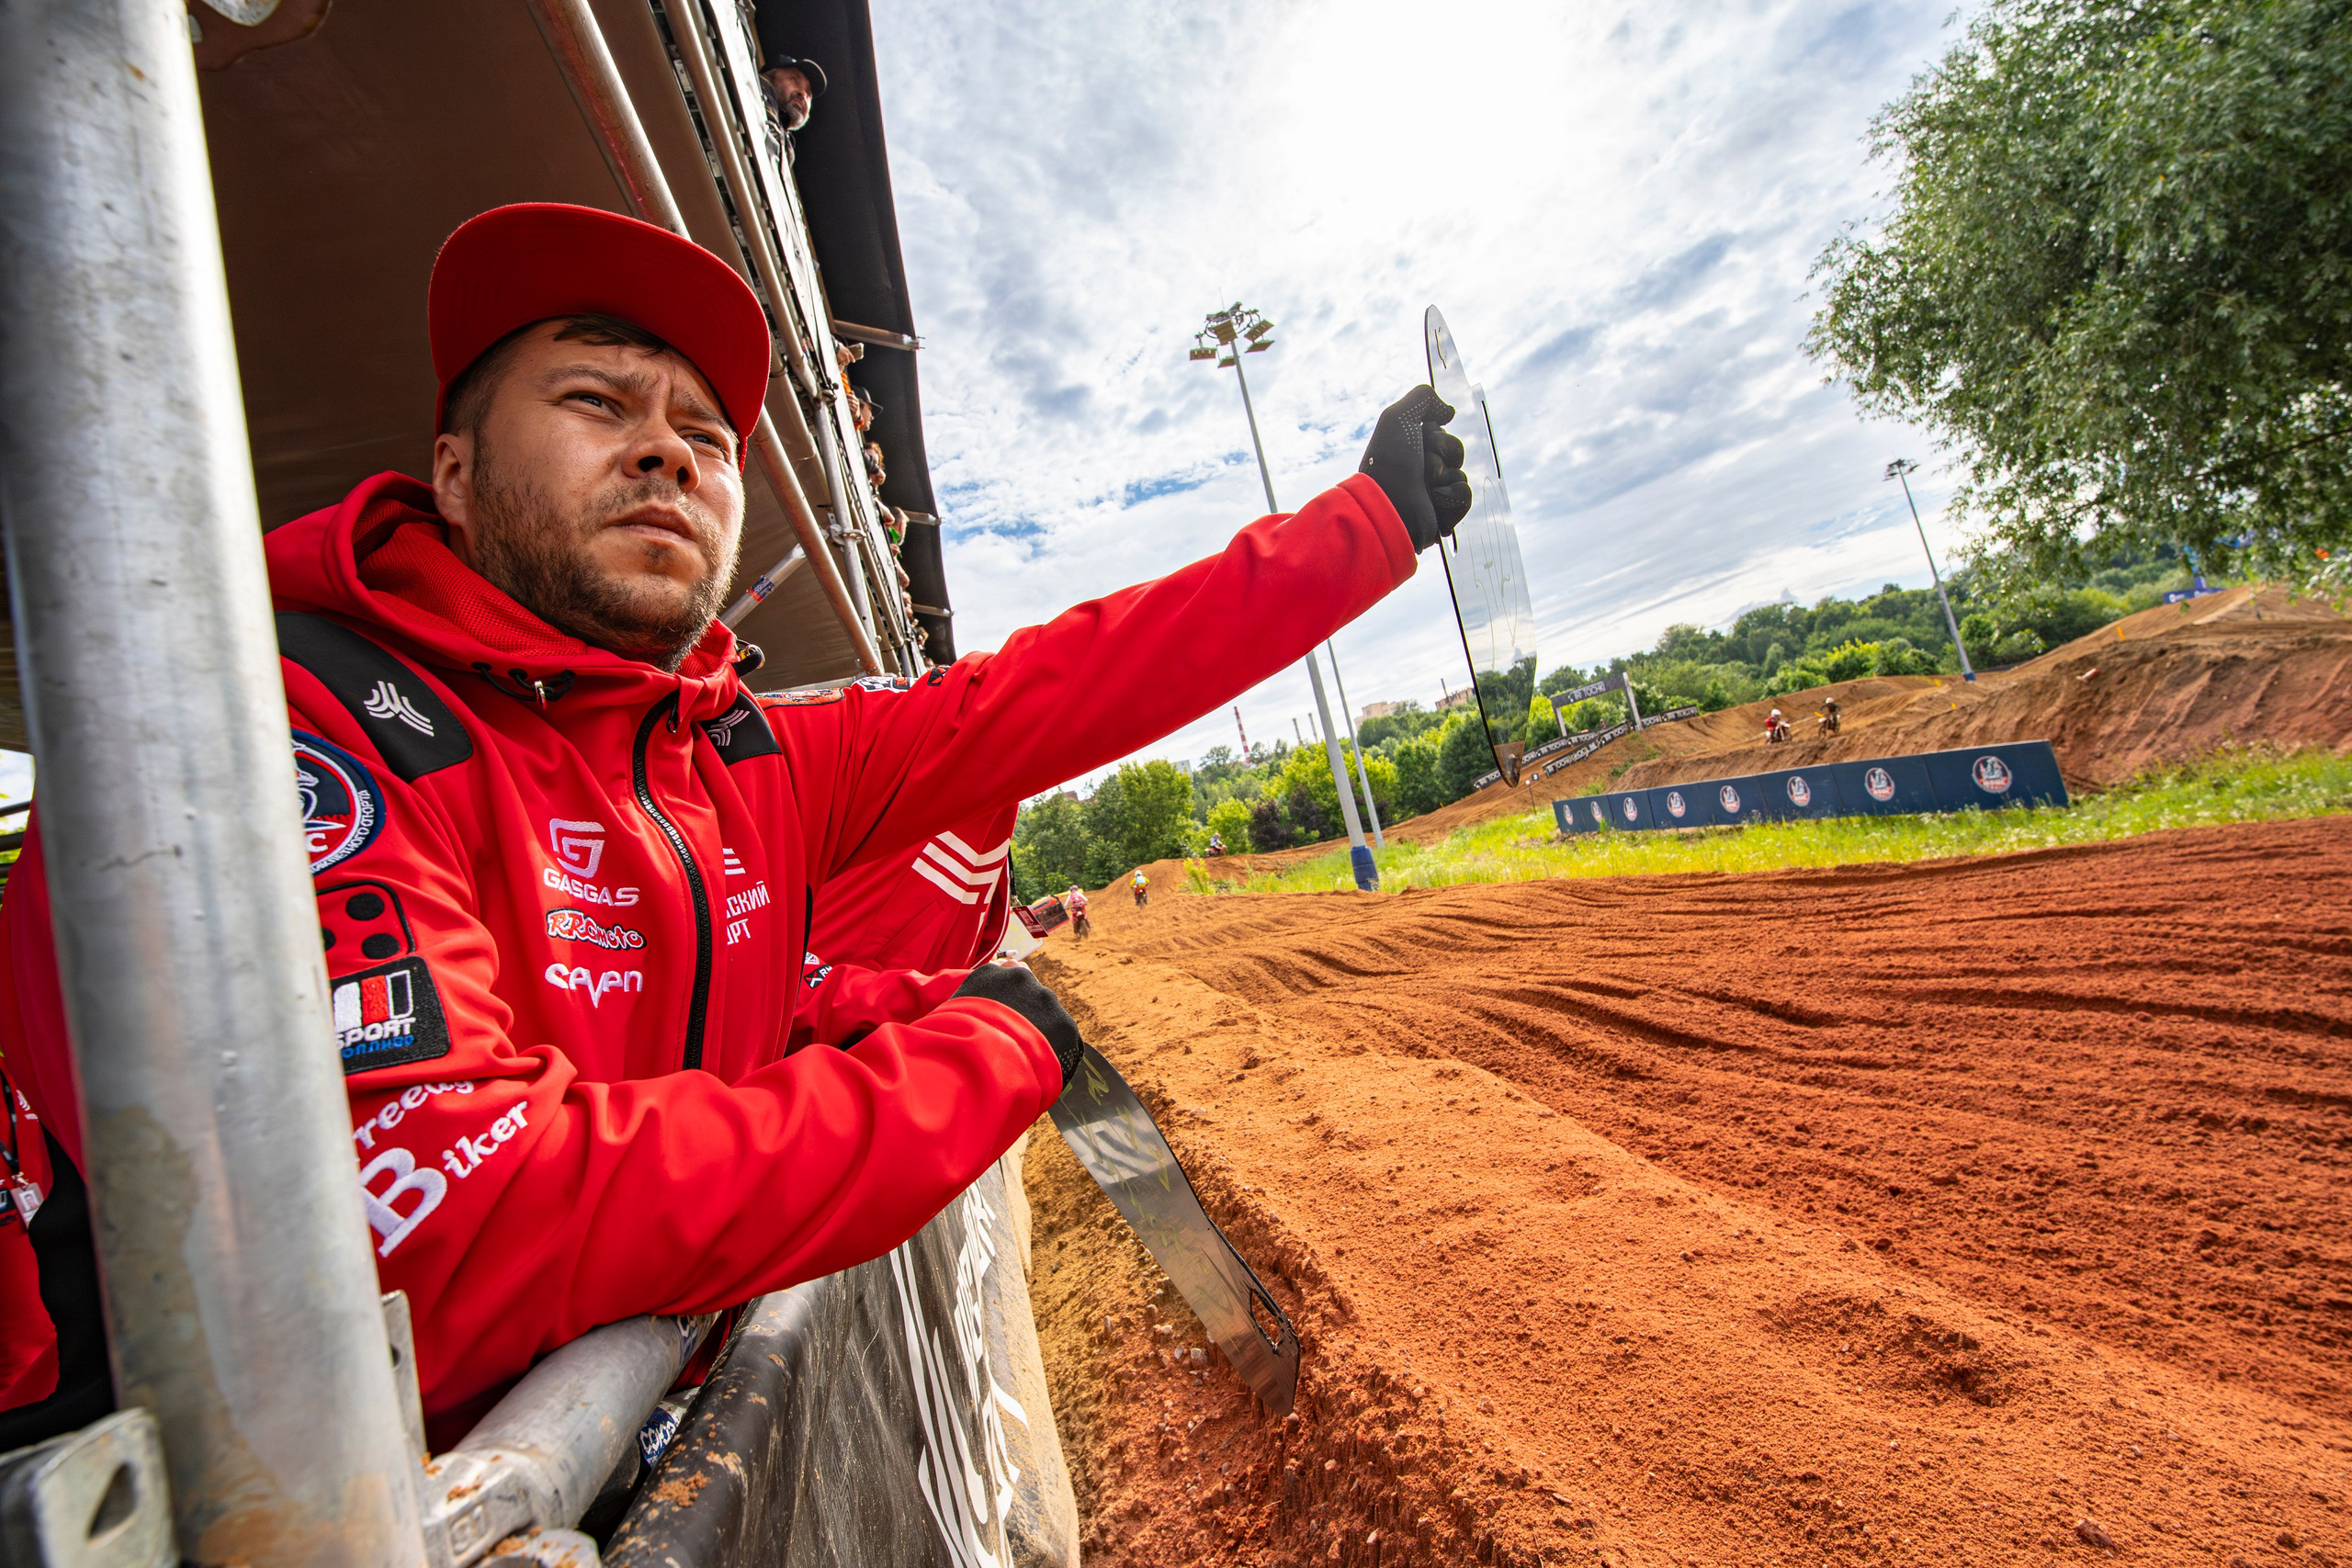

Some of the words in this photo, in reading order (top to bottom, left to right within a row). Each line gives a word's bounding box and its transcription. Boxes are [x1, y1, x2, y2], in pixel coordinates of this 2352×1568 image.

[543, 867, 640, 907] GASGAS
[726, 880, 770, 918] СКИЙ
[358, 1100, 528, 1258] Biker
